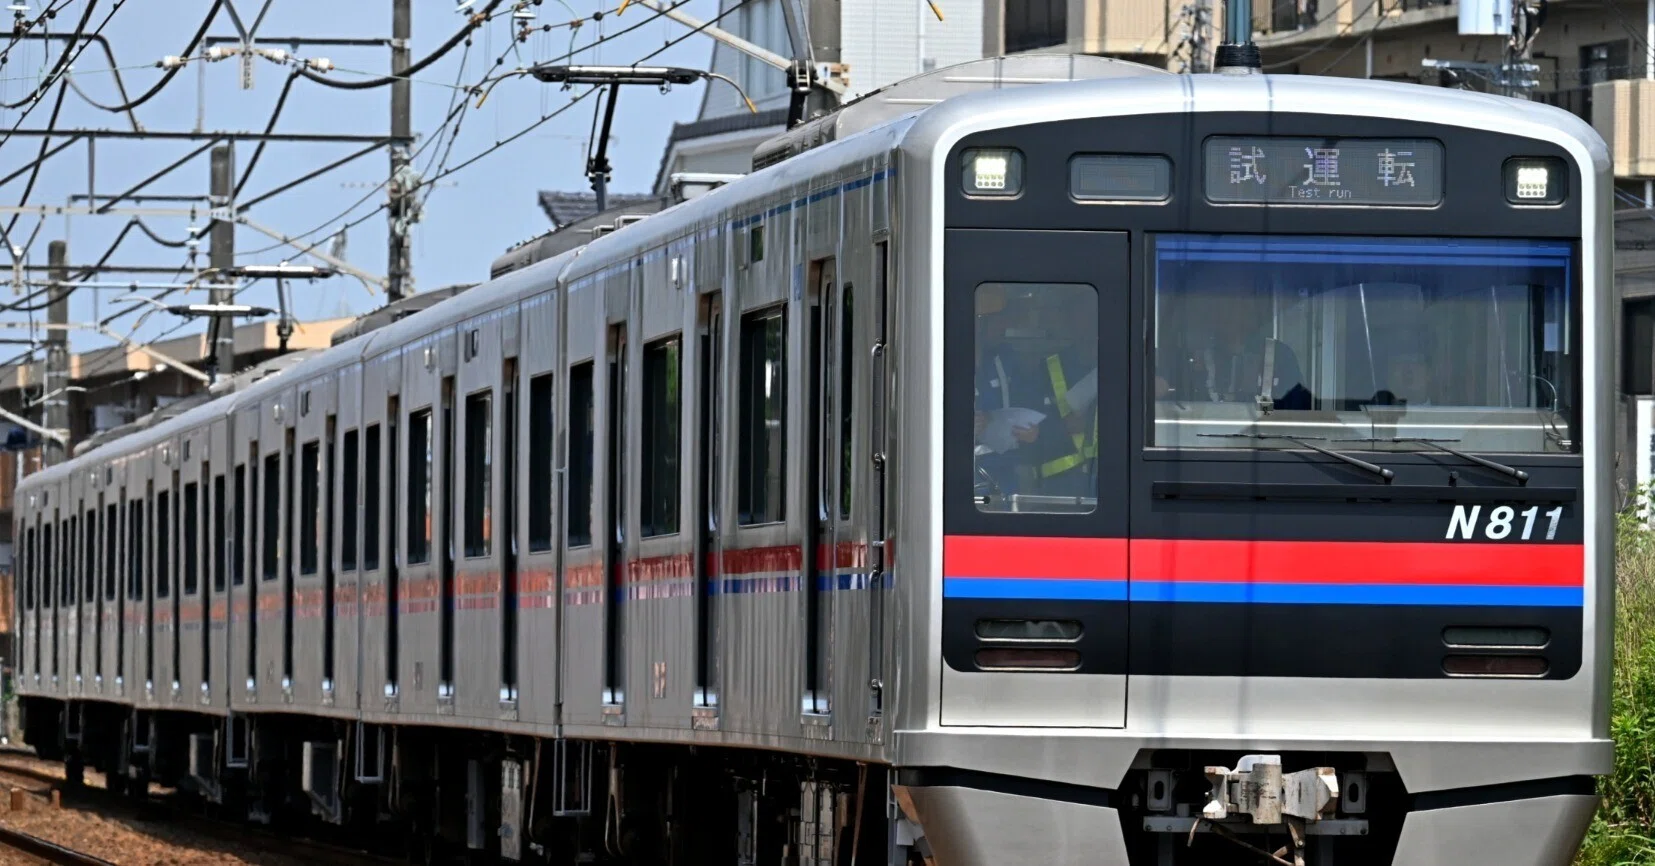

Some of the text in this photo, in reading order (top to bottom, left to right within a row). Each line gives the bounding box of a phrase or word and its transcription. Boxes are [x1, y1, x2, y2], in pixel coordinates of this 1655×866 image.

[1229, 146, 1415, 187] 試運転
[1288, 185, 1352, 199] Test run
[1445, 505, 1563, 540] N811
